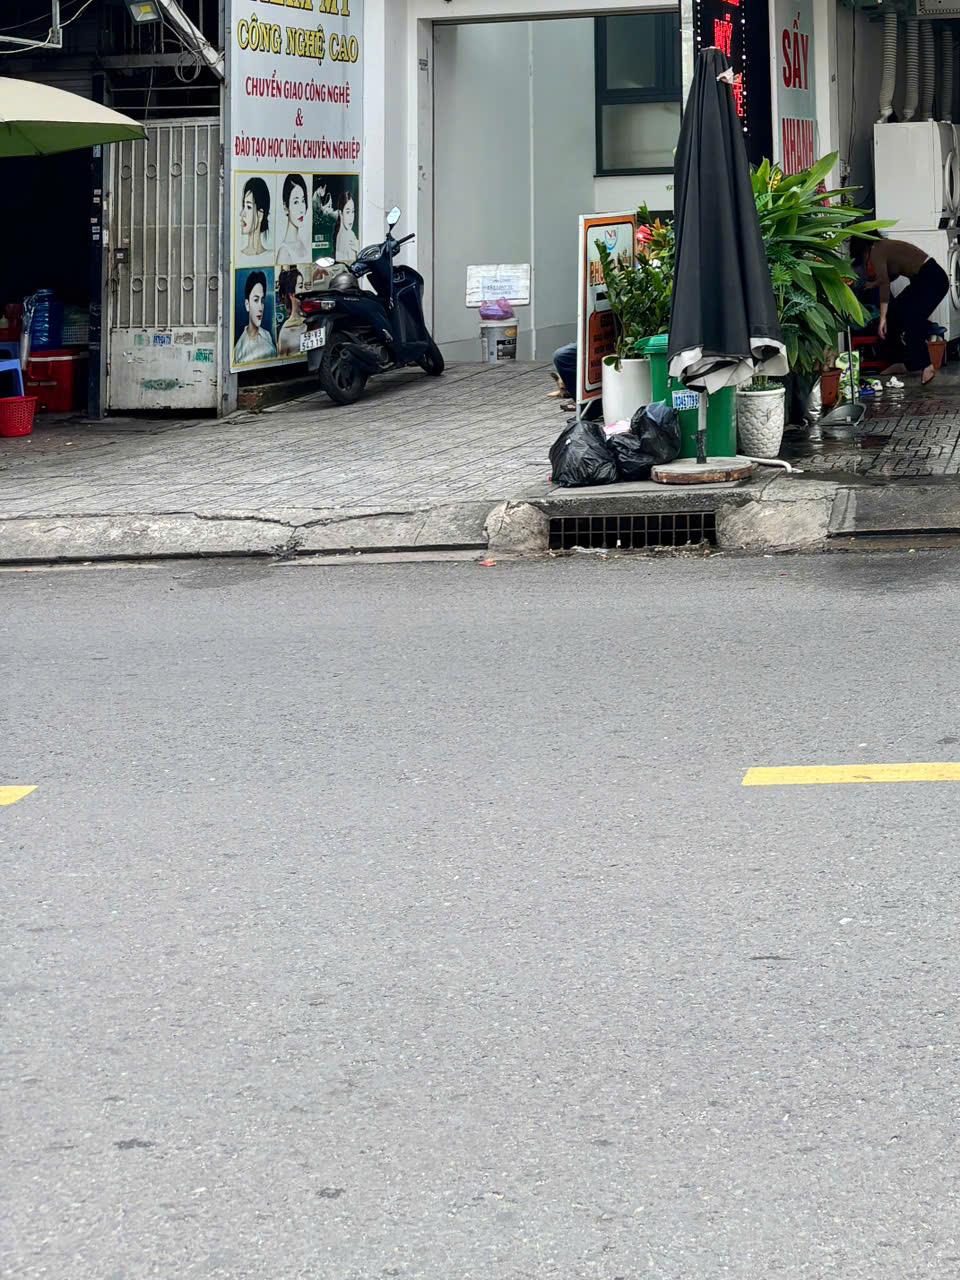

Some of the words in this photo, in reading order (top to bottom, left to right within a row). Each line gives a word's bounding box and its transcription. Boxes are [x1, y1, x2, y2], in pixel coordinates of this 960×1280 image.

[236, 13, 282, 55] CÔNG
[285, 24, 325, 65] NGHỆ
[329, 33, 359, 63] CAO
[782, 11, 809, 91] SẤY
[245, 70, 282, 98] CHUYỂN
[284, 81, 303, 101] GIAO
[305, 78, 326, 102] CÔNG
[327, 82, 350, 108] NGHỆ
[295, 108, 303, 126] &
[234, 130, 250, 157] ĐÀO
[251, 136, 266, 162] TẠO
[268, 137, 283, 163] HỌC
[285, 133, 301, 159] VIÊN
[302, 135, 331, 160] CHUYÊN
[332, 136, 360, 163] NGHIỆP
